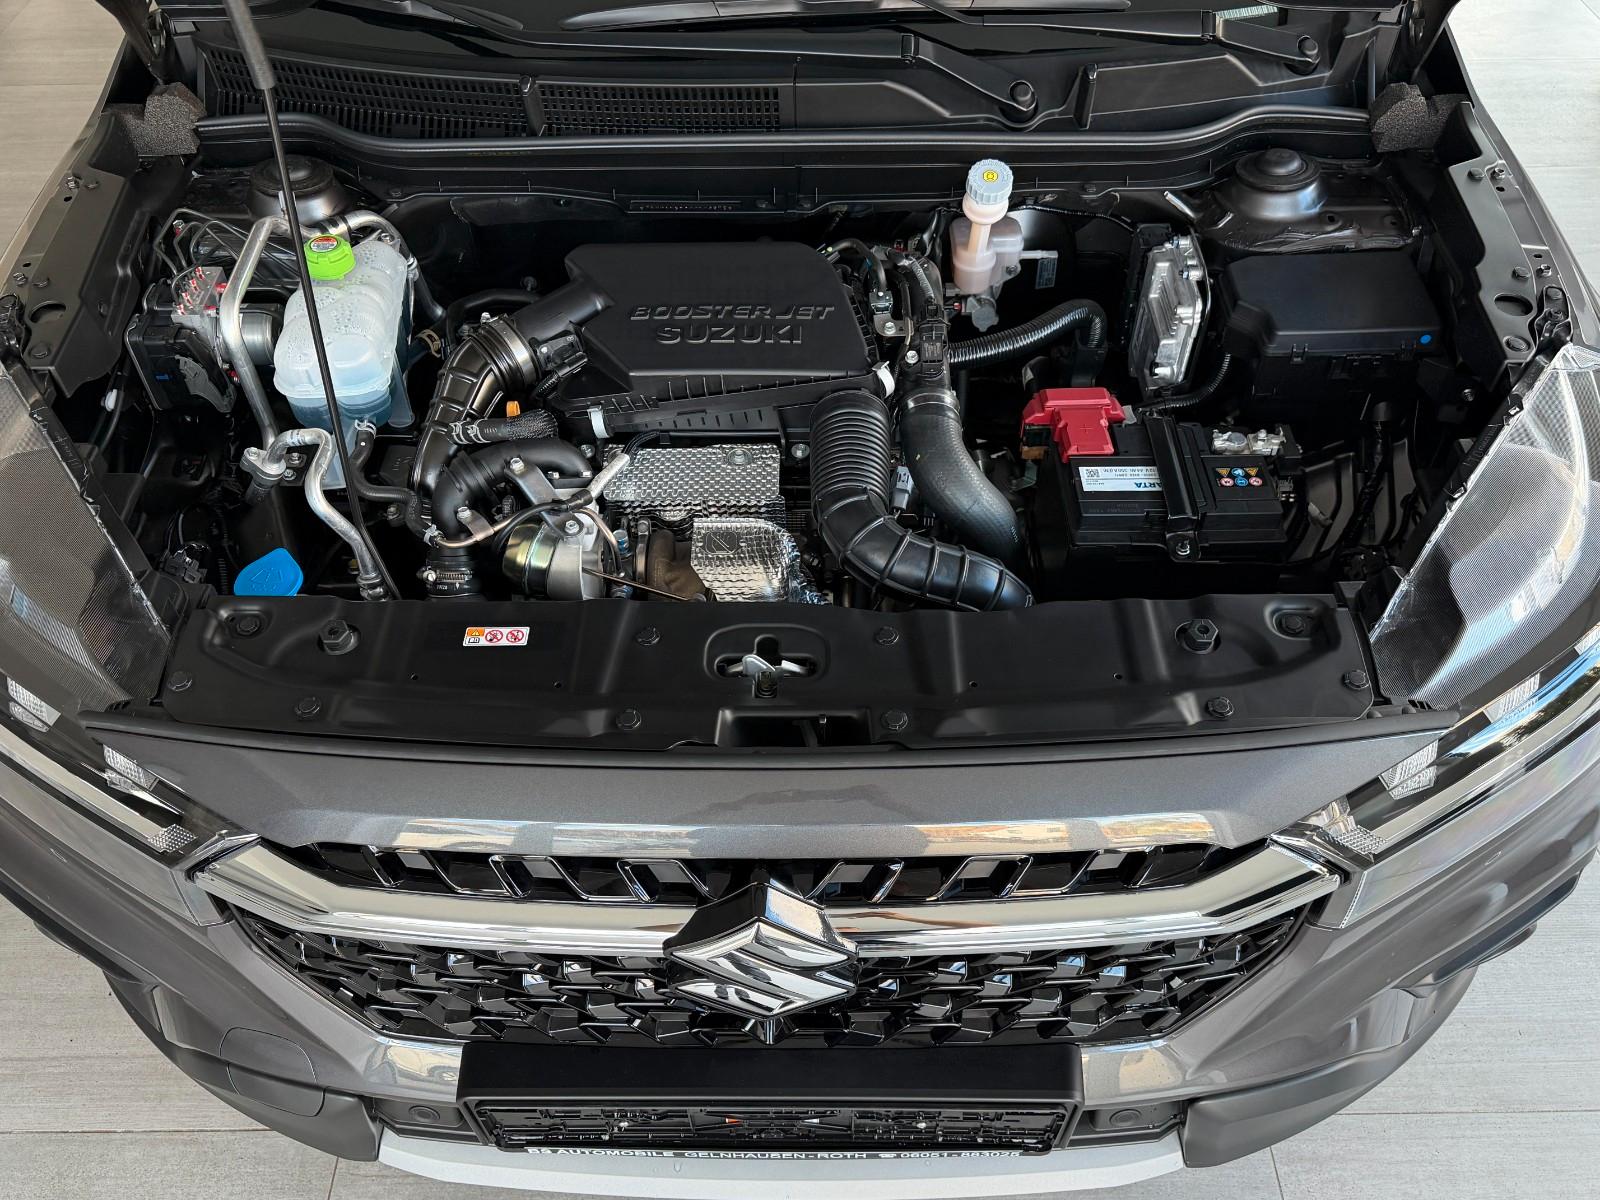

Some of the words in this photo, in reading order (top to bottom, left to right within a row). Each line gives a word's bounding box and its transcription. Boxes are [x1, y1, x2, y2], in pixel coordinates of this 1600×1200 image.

[630, 305, 835, 320] BOOSTERJET
[655, 323, 802, 345] SUZUKI
[557, 1149, 675, 1157] AUTOMOBILE
